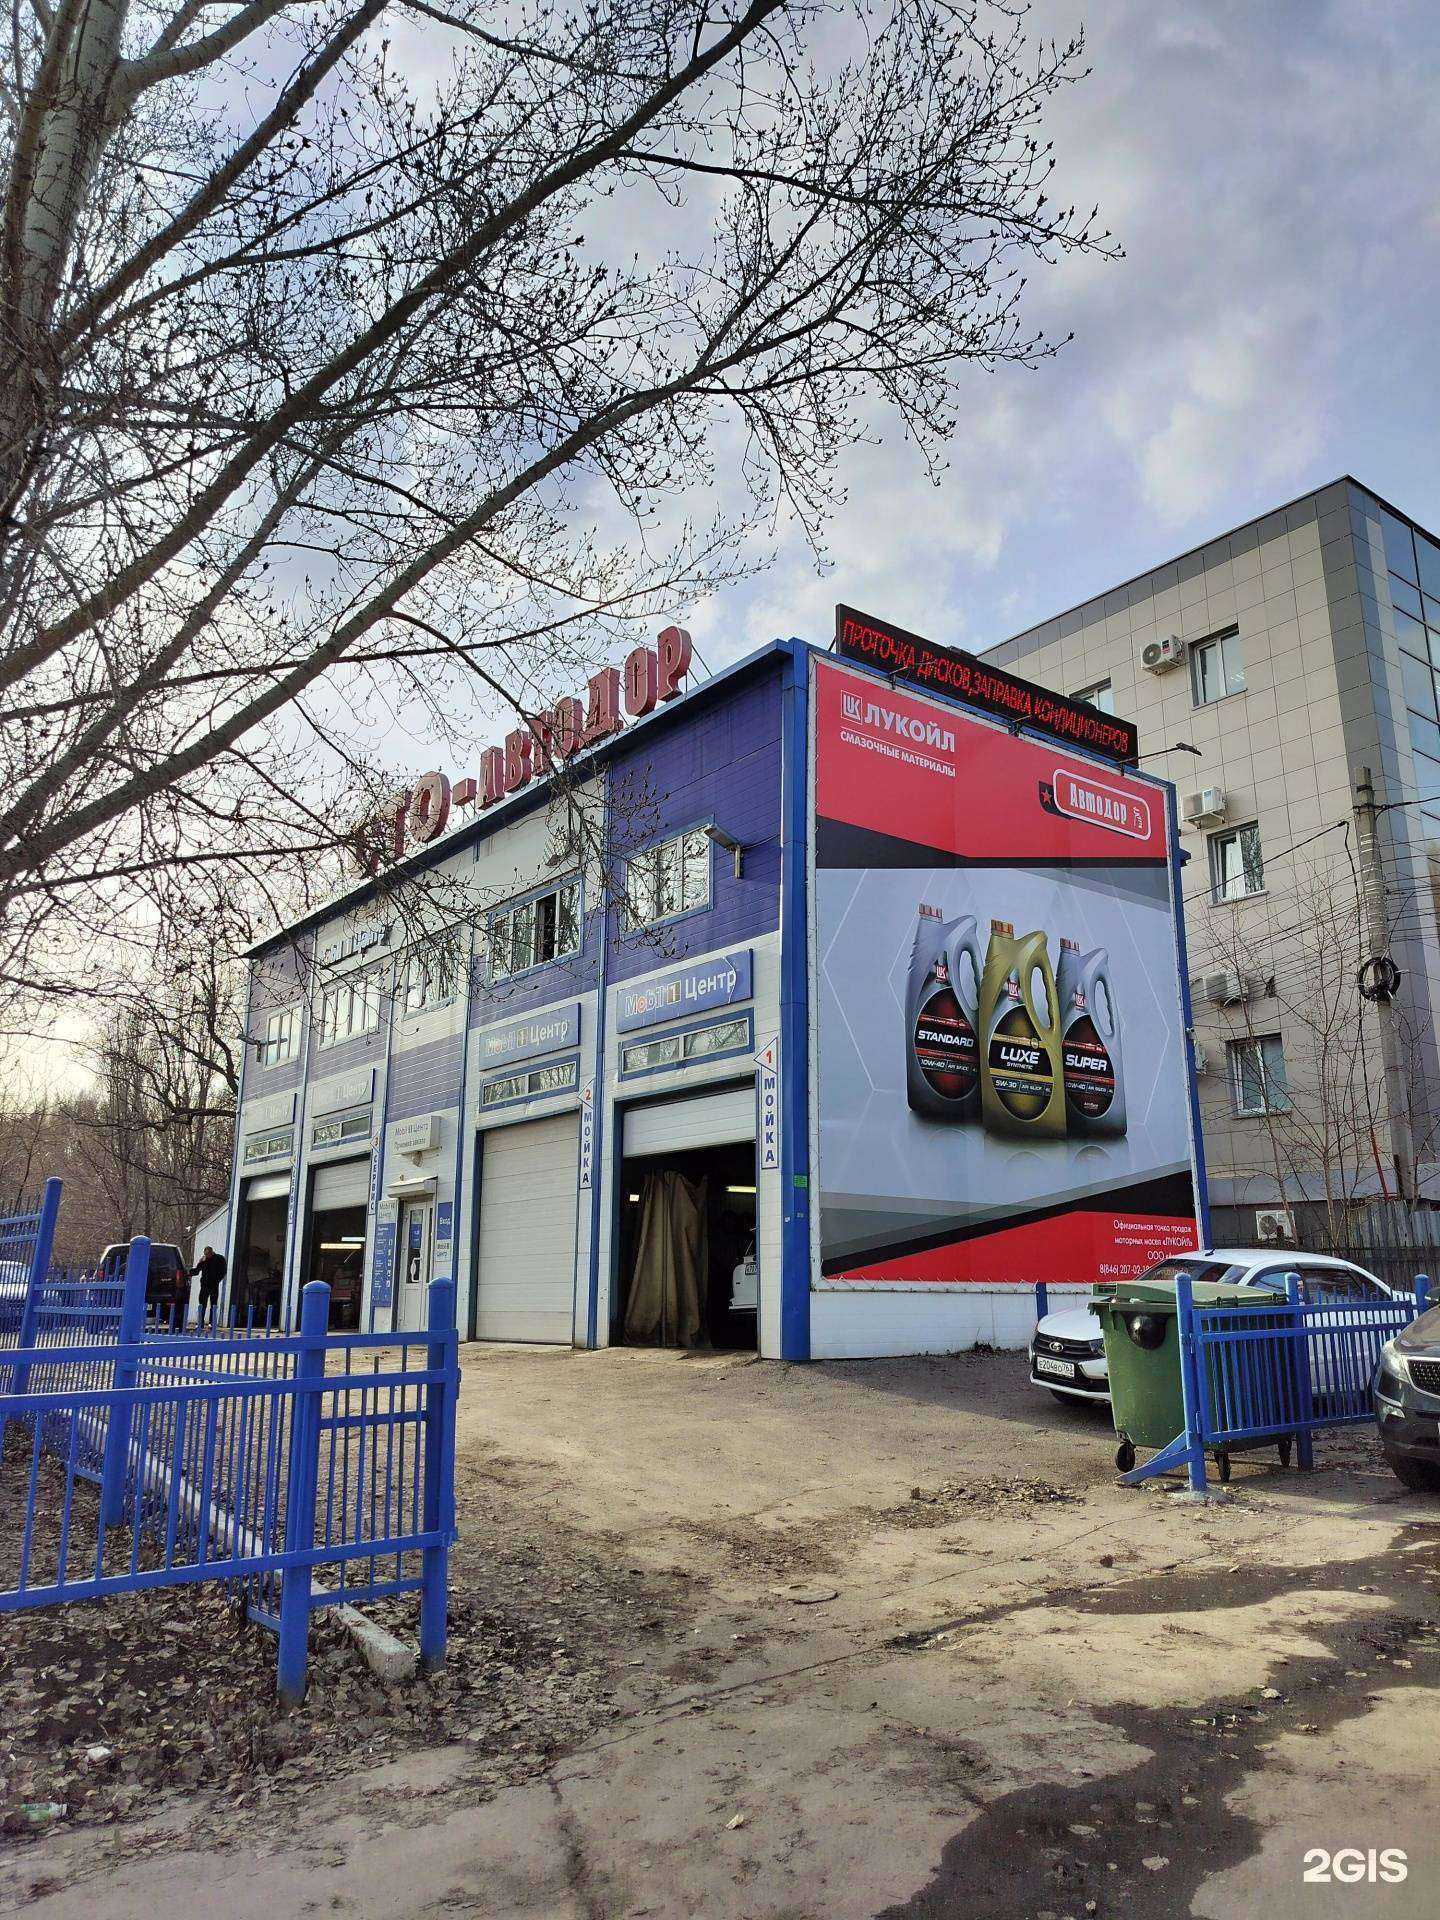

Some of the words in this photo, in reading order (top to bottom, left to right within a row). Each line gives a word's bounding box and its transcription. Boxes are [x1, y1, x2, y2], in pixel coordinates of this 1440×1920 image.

[843, 619, 916, 670] ПРОТОЧКА
[1034, 696, 1129, 753] КОНДИЦИОНЕРОВ
[864, 703, 955, 753] ЛУКОЙЛ
[840, 730, 900, 760] СМАЗОЧНЫЕ
[901, 751, 956, 777] МАТЕРИАЛЫ
[1069, 782, 1128, 825] Автодор
[685, 970, 736, 1001] Центр
[530, 1018, 569, 1046] Центр
[917, 1029, 974, 1048] STANDARD
[765, 1050, 772, 1063] 1
[1000, 1046, 1041, 1065] LUXE
[1065, 1053, 1108, 1072] SUPER
[995, 1079, 1018, 1089] 5W-30
[584, 1089, 591, 1101] 2
[764, 1077, 775, 1163] МОЙКА
[582, 1111, 592, 1183] МОЙКА
[1113, 1219, 1154, 1231] Официальная
[1154, 1224, 1171, 1232] точка
[1171, 1225, 1192, 1234] продаж
[1114, 1237, 1143, 1247] моторных
[1144, 1238, 1162, 1246] масел
[1147, 1250, 1165, 1260] ООО
[1099, 1264, 1119, 1276] 8(846)
